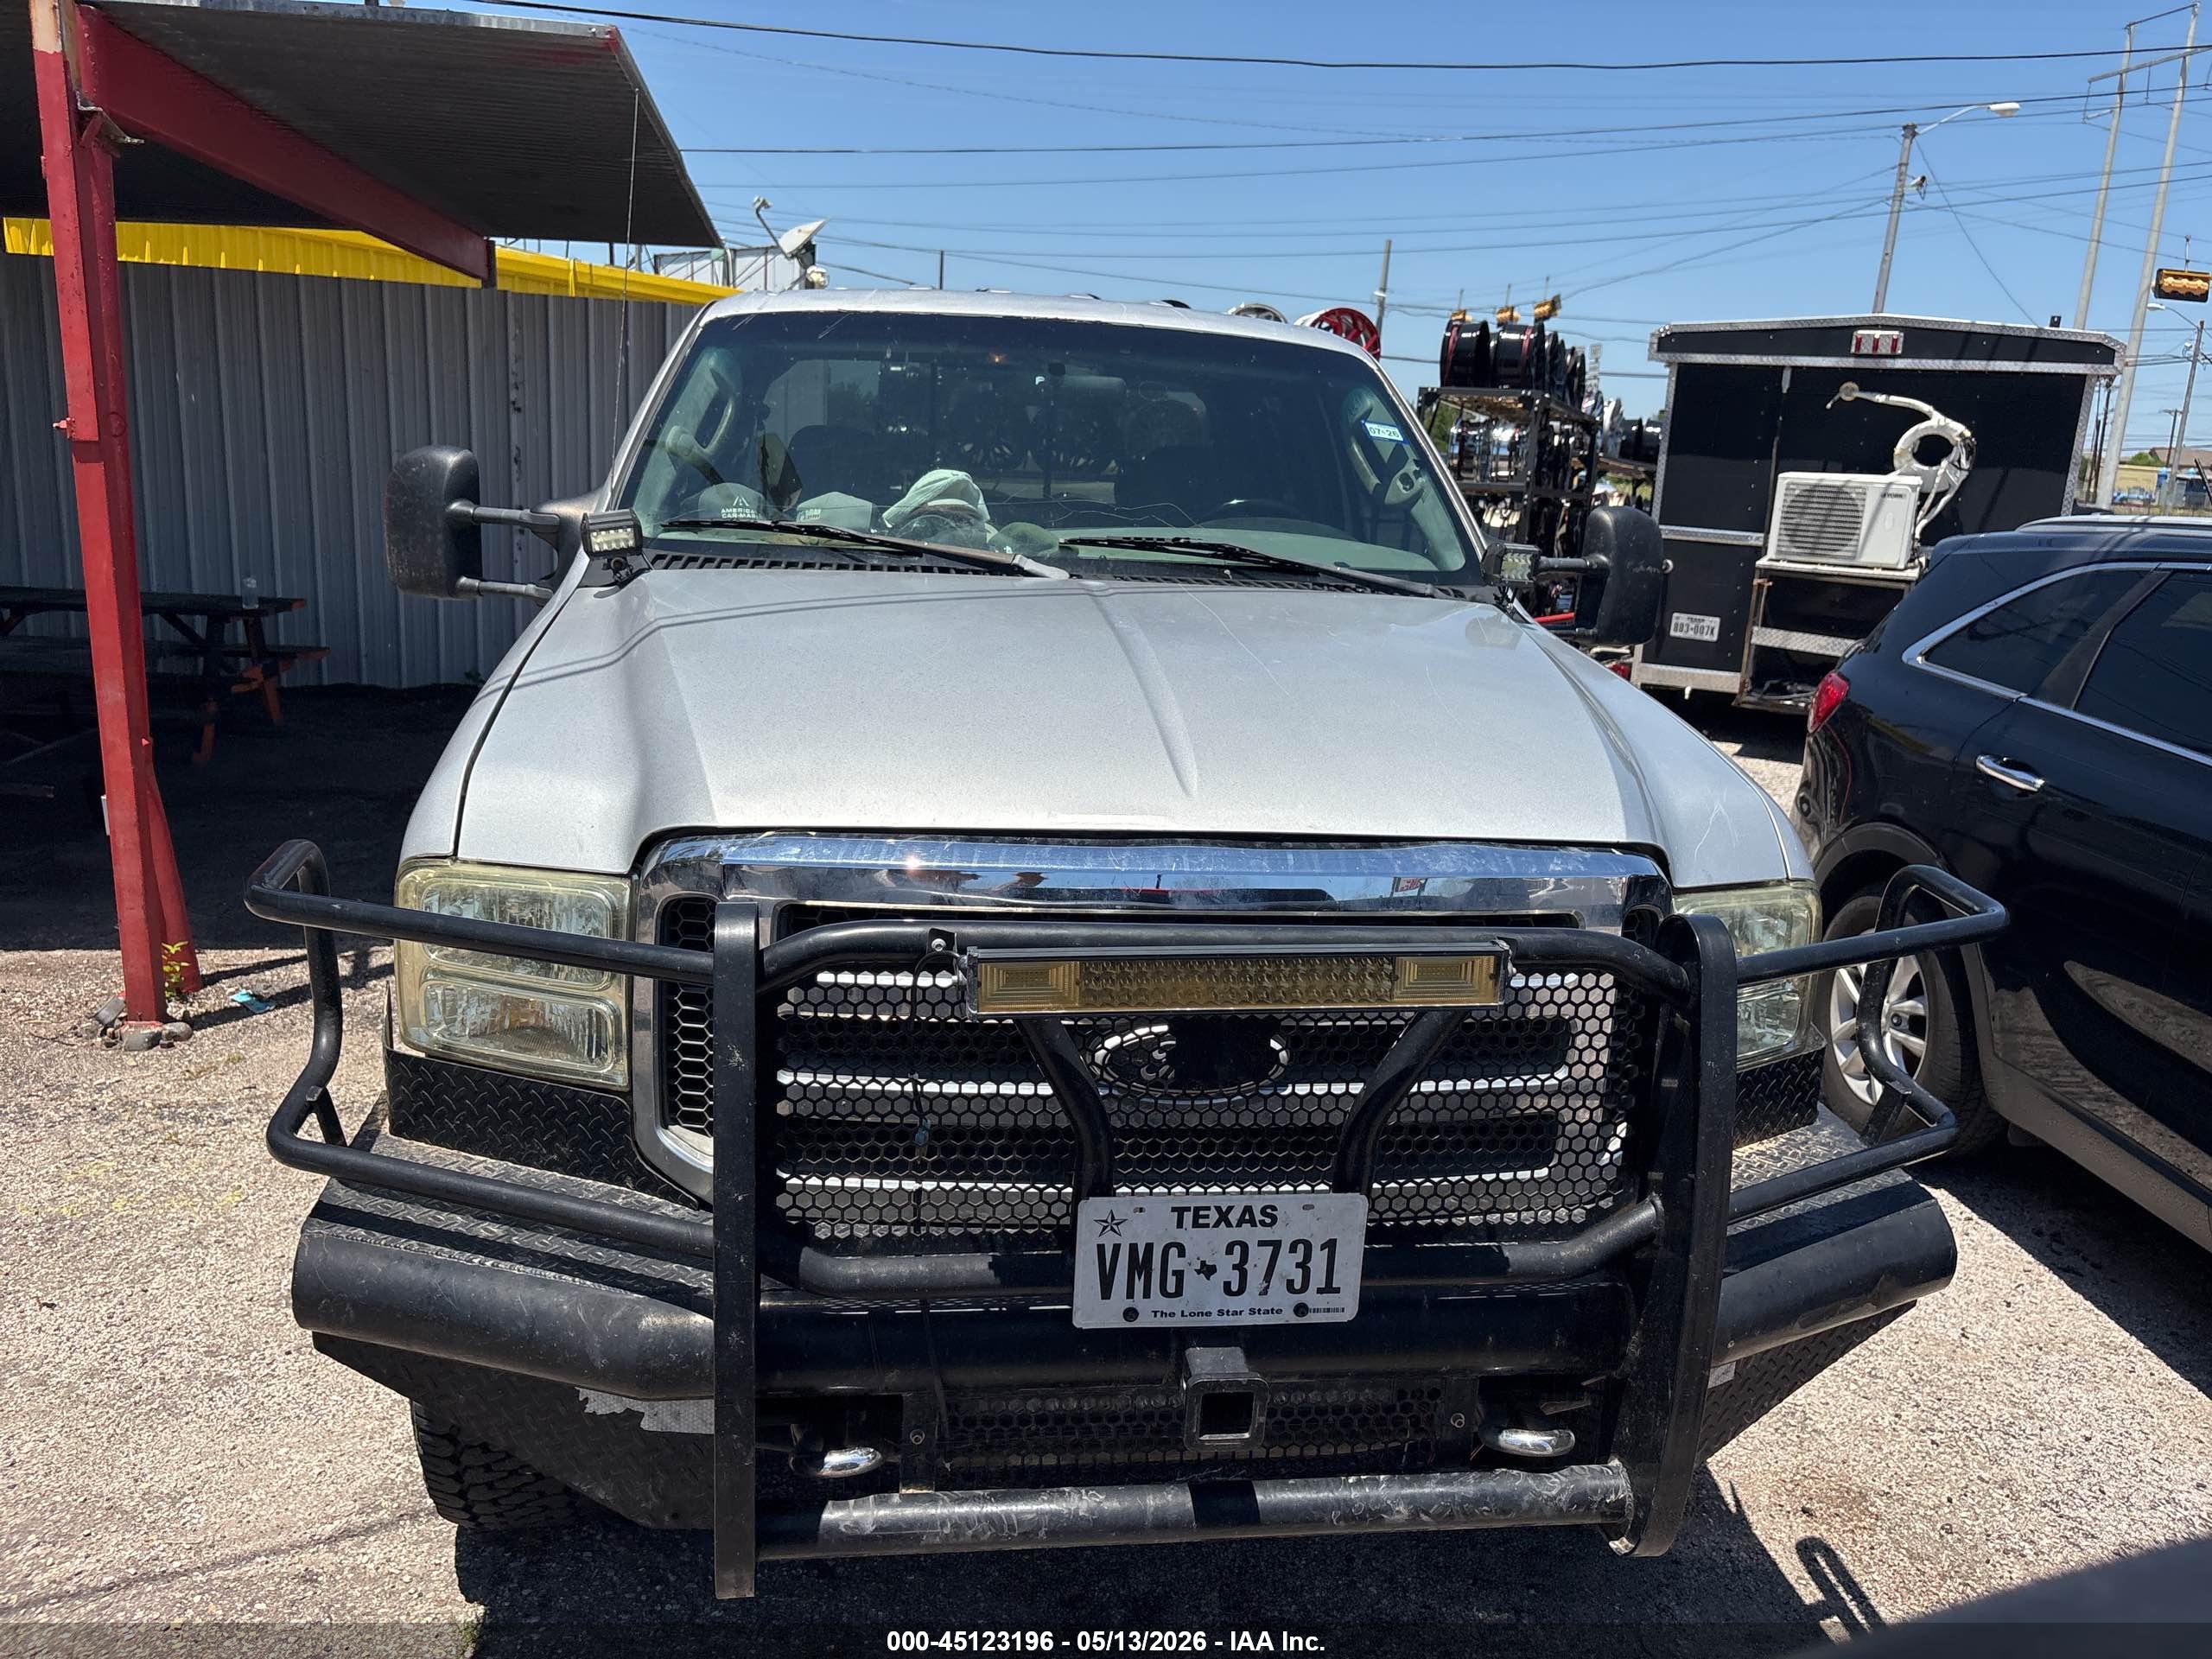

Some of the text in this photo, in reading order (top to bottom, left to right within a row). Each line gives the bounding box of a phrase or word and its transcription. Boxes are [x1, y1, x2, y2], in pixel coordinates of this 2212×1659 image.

[1170, 1205, 1279, 1229] TEXAS
[1096, 1237, 1341, 1300] VMG 3731
[1151, 1306, 1283, 1319] The Lone Star State
